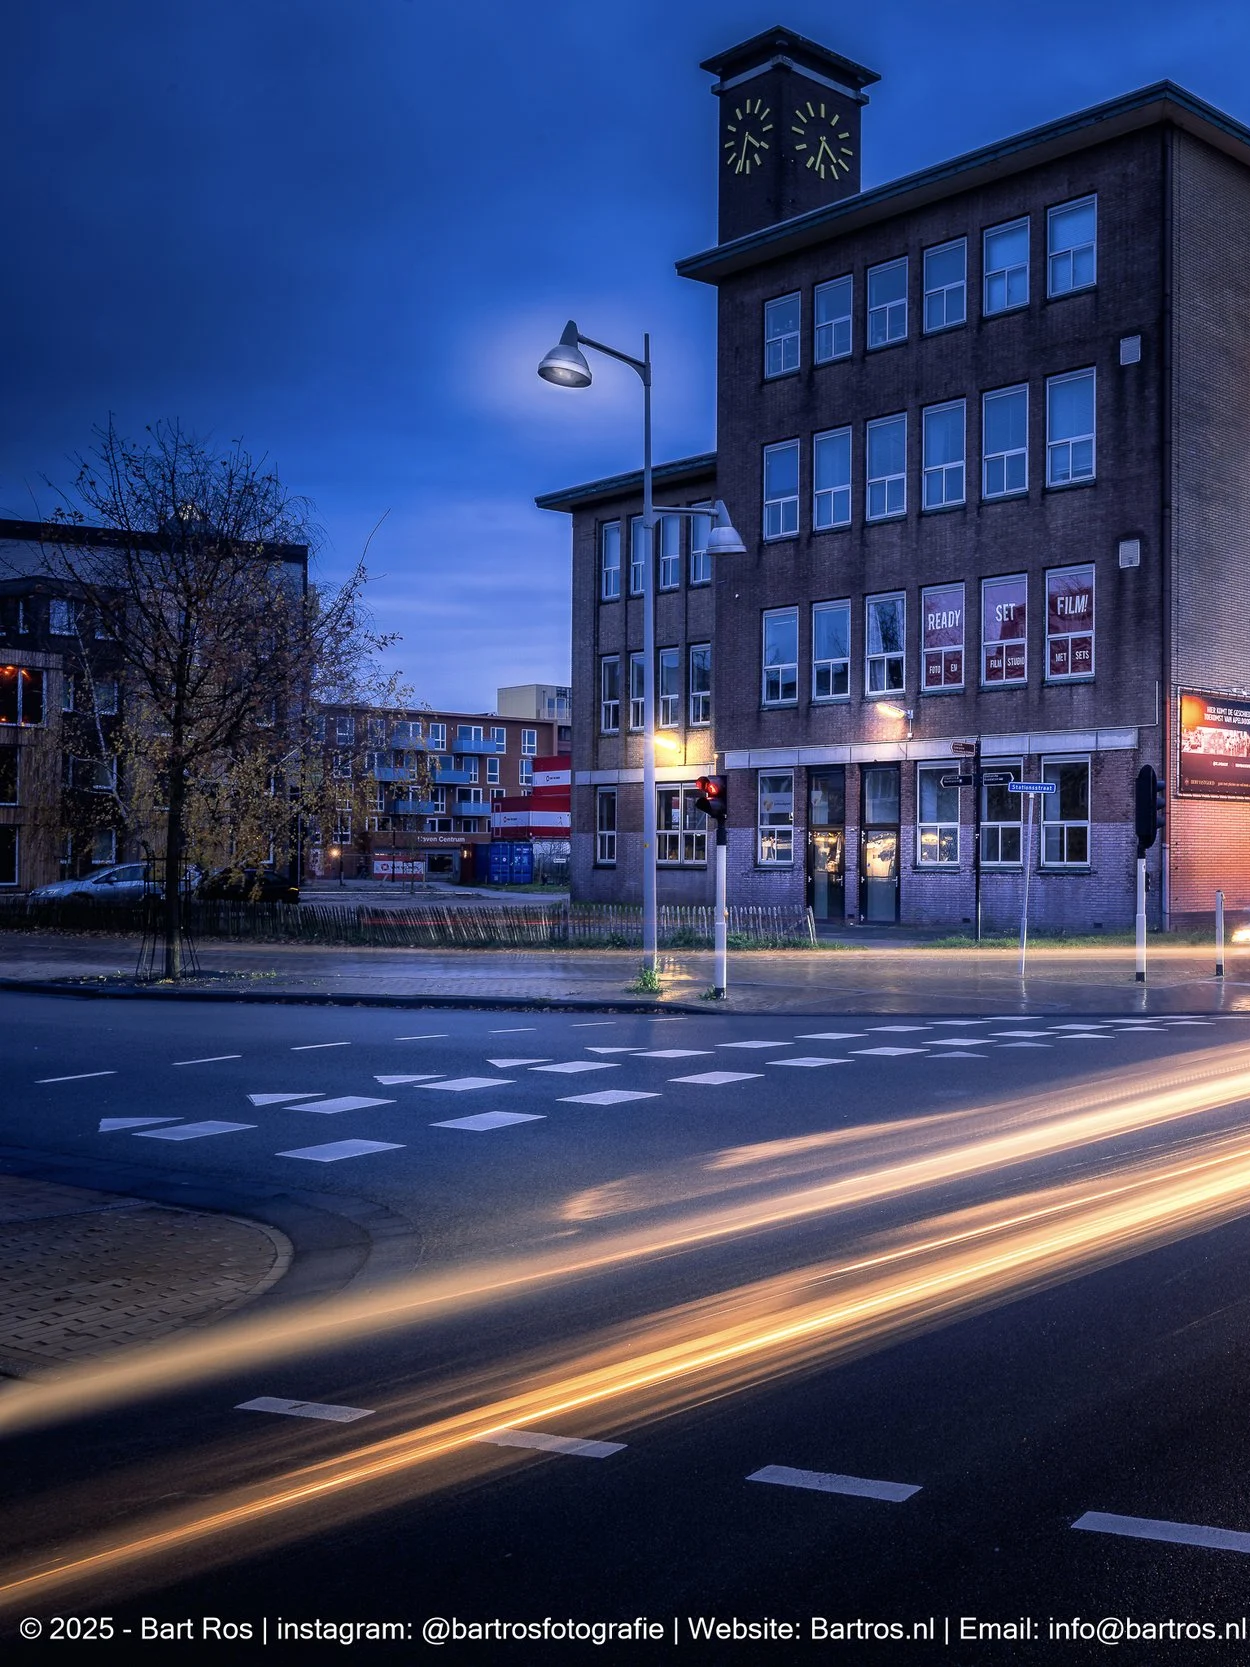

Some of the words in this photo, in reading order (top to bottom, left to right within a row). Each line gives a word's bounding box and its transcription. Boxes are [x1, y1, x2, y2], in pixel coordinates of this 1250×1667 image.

[928, 609, 961, 630] READY
[995, 603, 1015, 622] SET
[1057, 594, 1089, 615] FILM!
[929, 664, 941, 674] FOTO
[990, 659, 1002, 668] FILM
[1007, 656, 1025, 666] STUDIO
[1055, 652, 1067, 662] MET
[1075, 650, 1089, 660] SETS
[1228, 708, 1234, 716] DE
